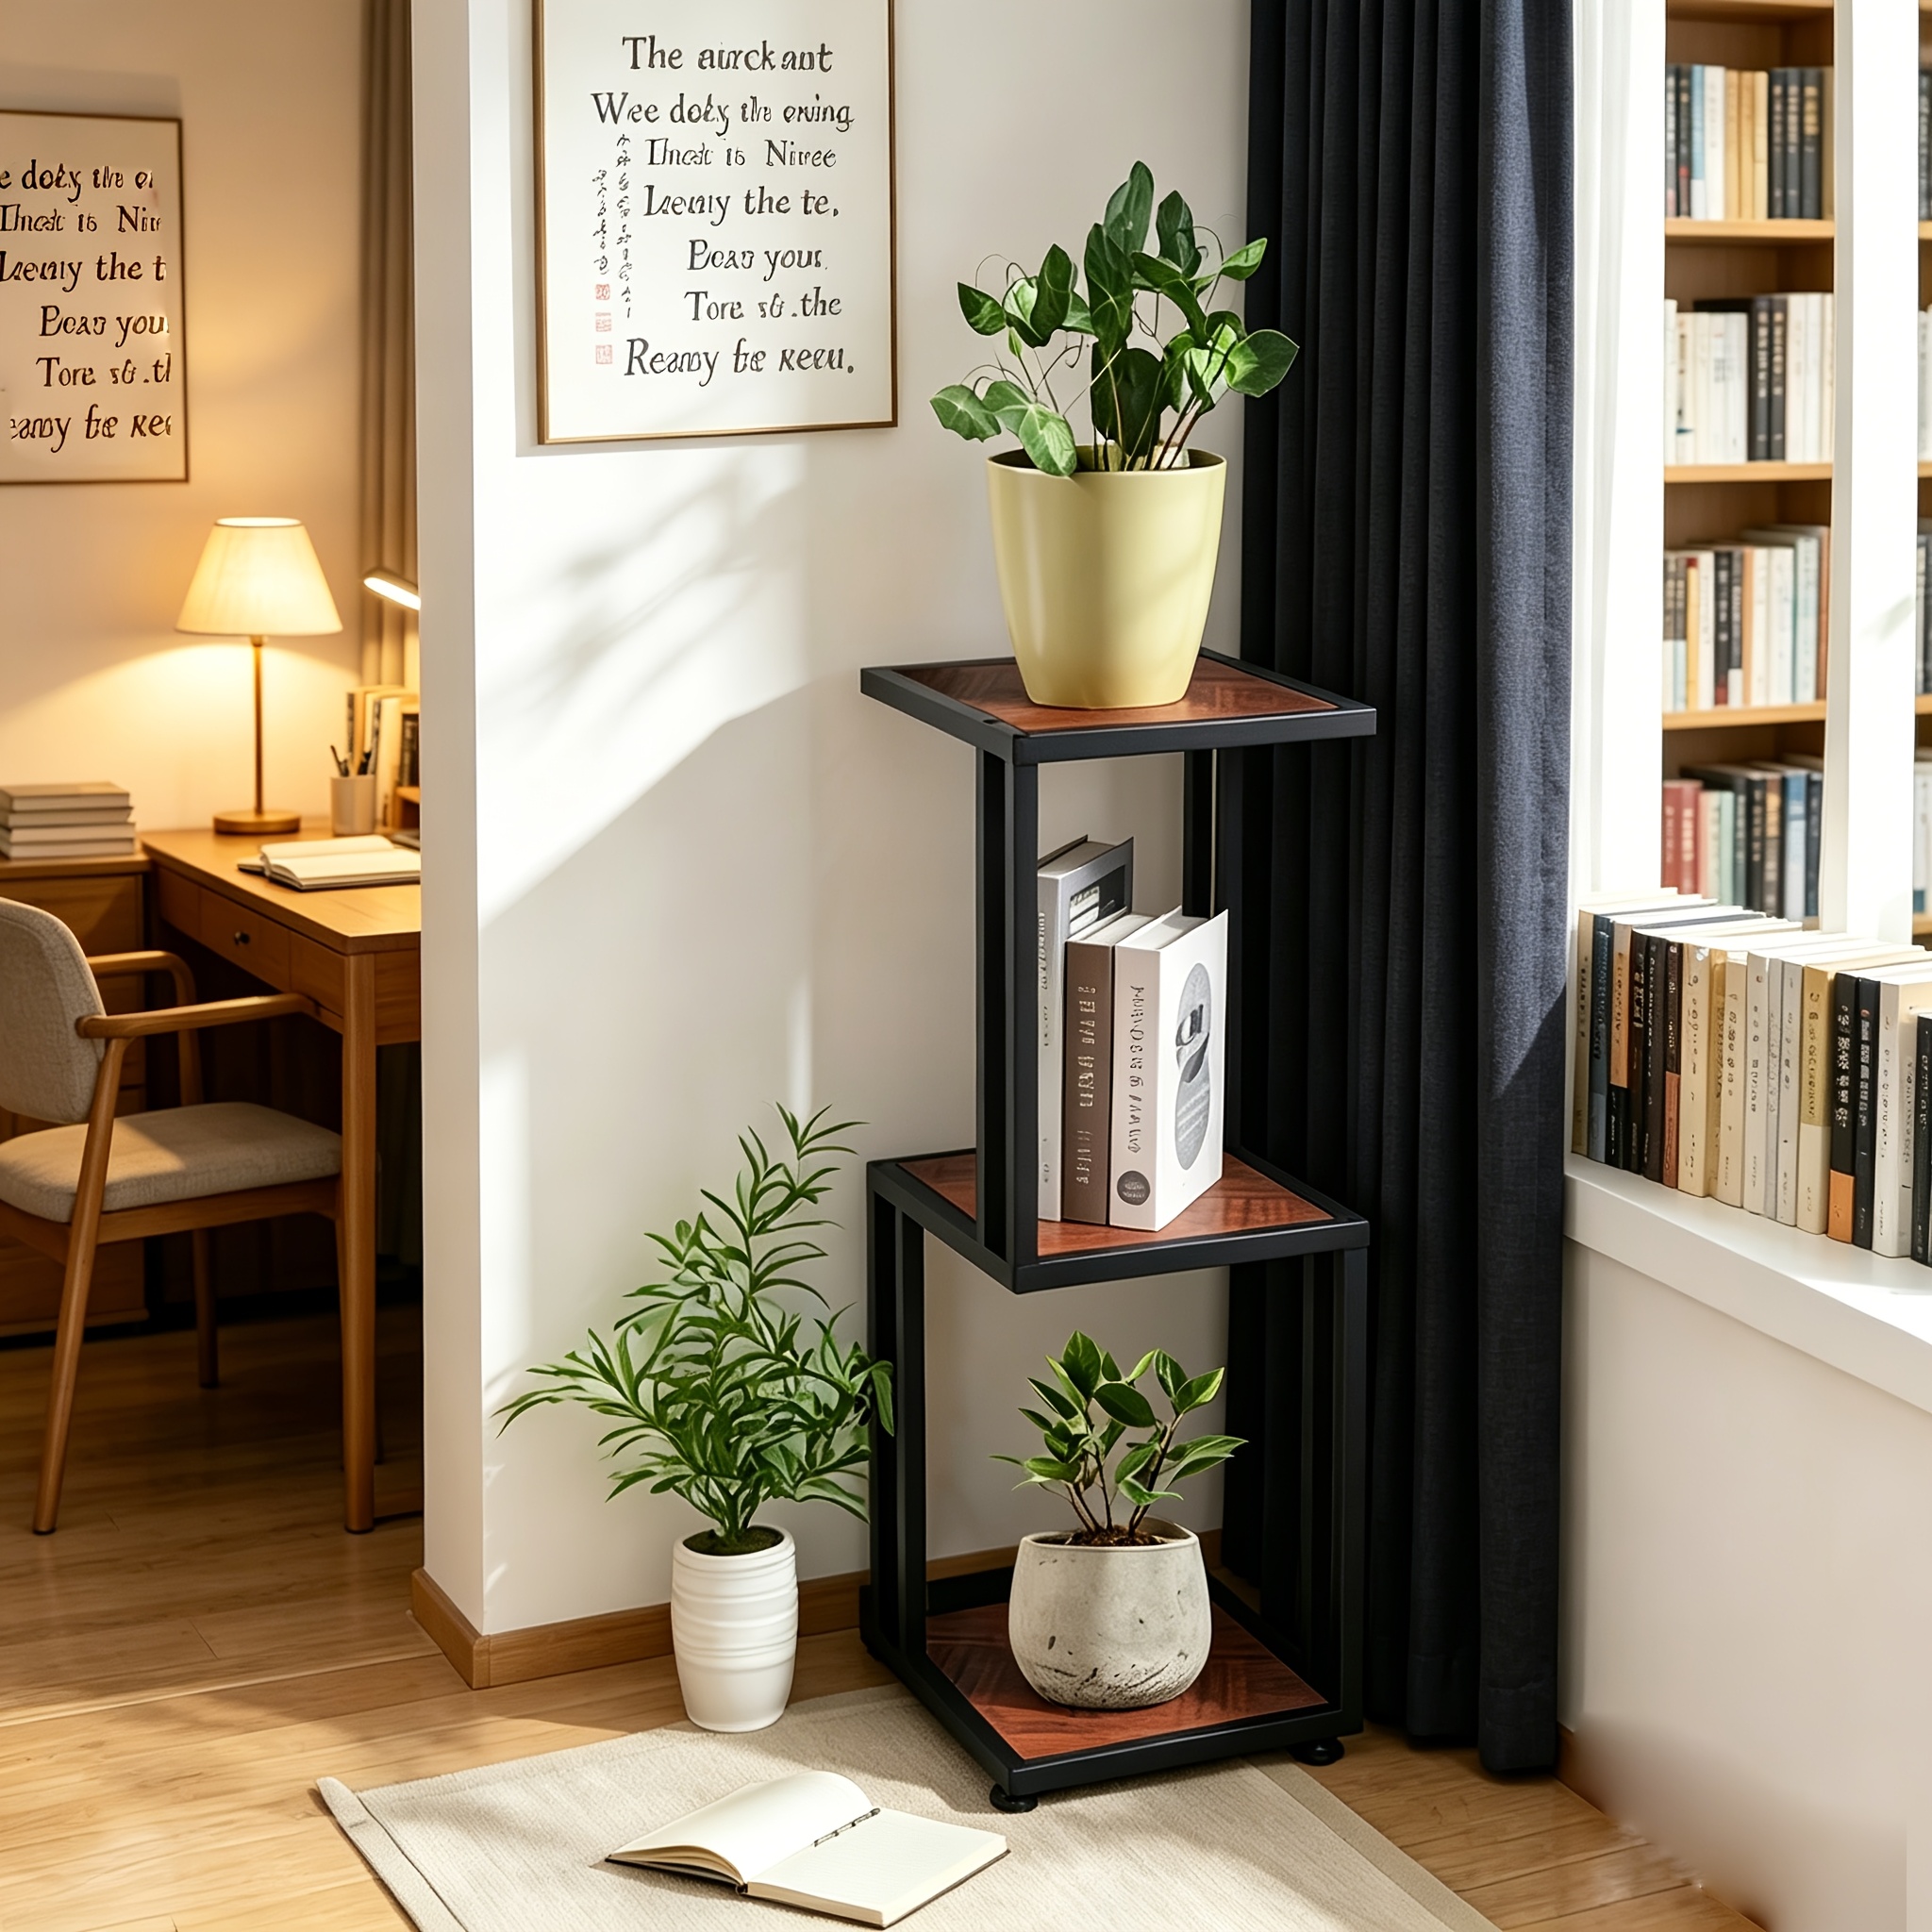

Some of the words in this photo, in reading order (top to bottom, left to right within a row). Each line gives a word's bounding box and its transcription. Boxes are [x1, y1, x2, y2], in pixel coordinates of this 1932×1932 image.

[622, 35, 683, 71] The
[590, 92, 660, 125] Wee
[744, 186, 791, 215] the
[95, 252, 143, 281] the
